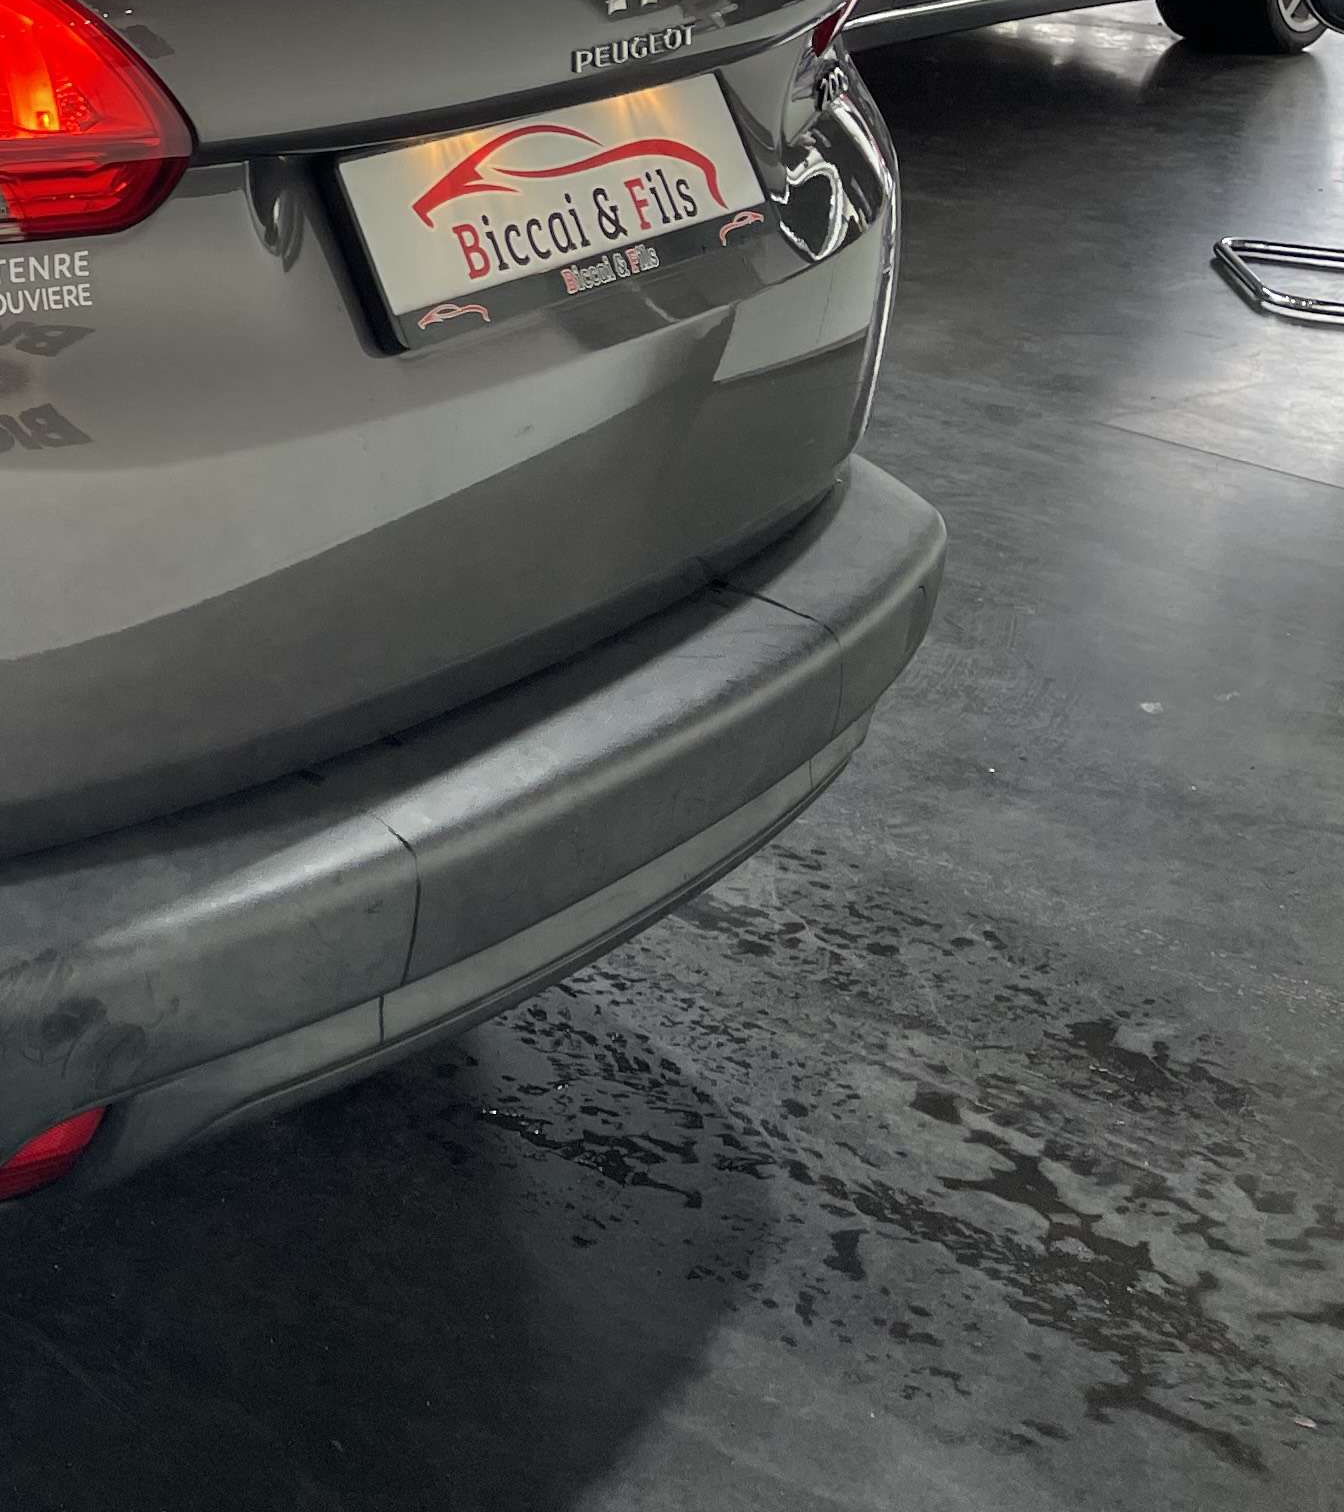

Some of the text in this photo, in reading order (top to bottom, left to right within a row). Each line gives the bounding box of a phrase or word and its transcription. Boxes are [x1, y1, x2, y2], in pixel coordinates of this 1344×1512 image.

[574, 24, 696, 73] PEUGEOT
[451, 168, 698, 280] Biccai & Fils
[560, 244, 661, 295] Biccai & Fils
